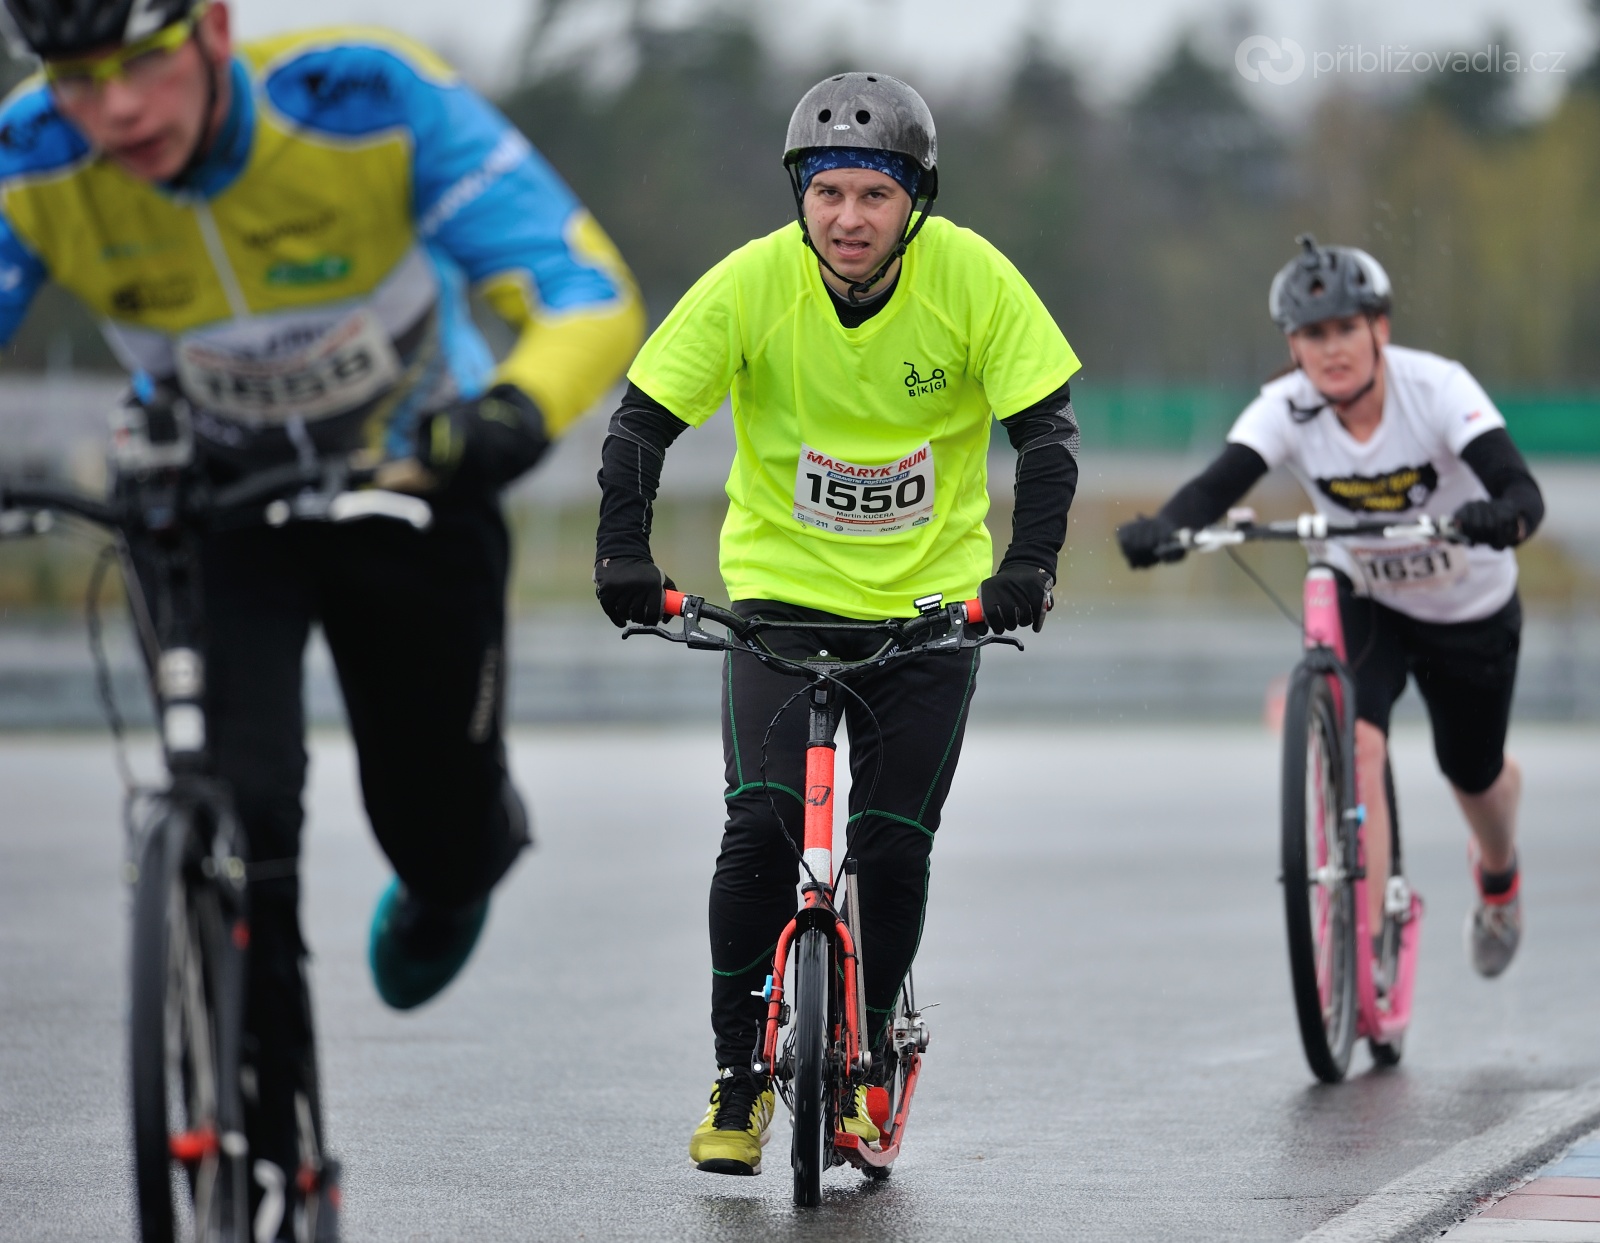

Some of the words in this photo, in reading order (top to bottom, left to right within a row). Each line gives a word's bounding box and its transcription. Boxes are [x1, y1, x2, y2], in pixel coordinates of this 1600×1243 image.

[806, 450, 895, 478] MASARYK
[897, 447, 928, 472] RUN
[805, 473, 926, 514] 1550
[836, 511, 862, 519] Martin
[1369, 550, 1451, 582] 1631
